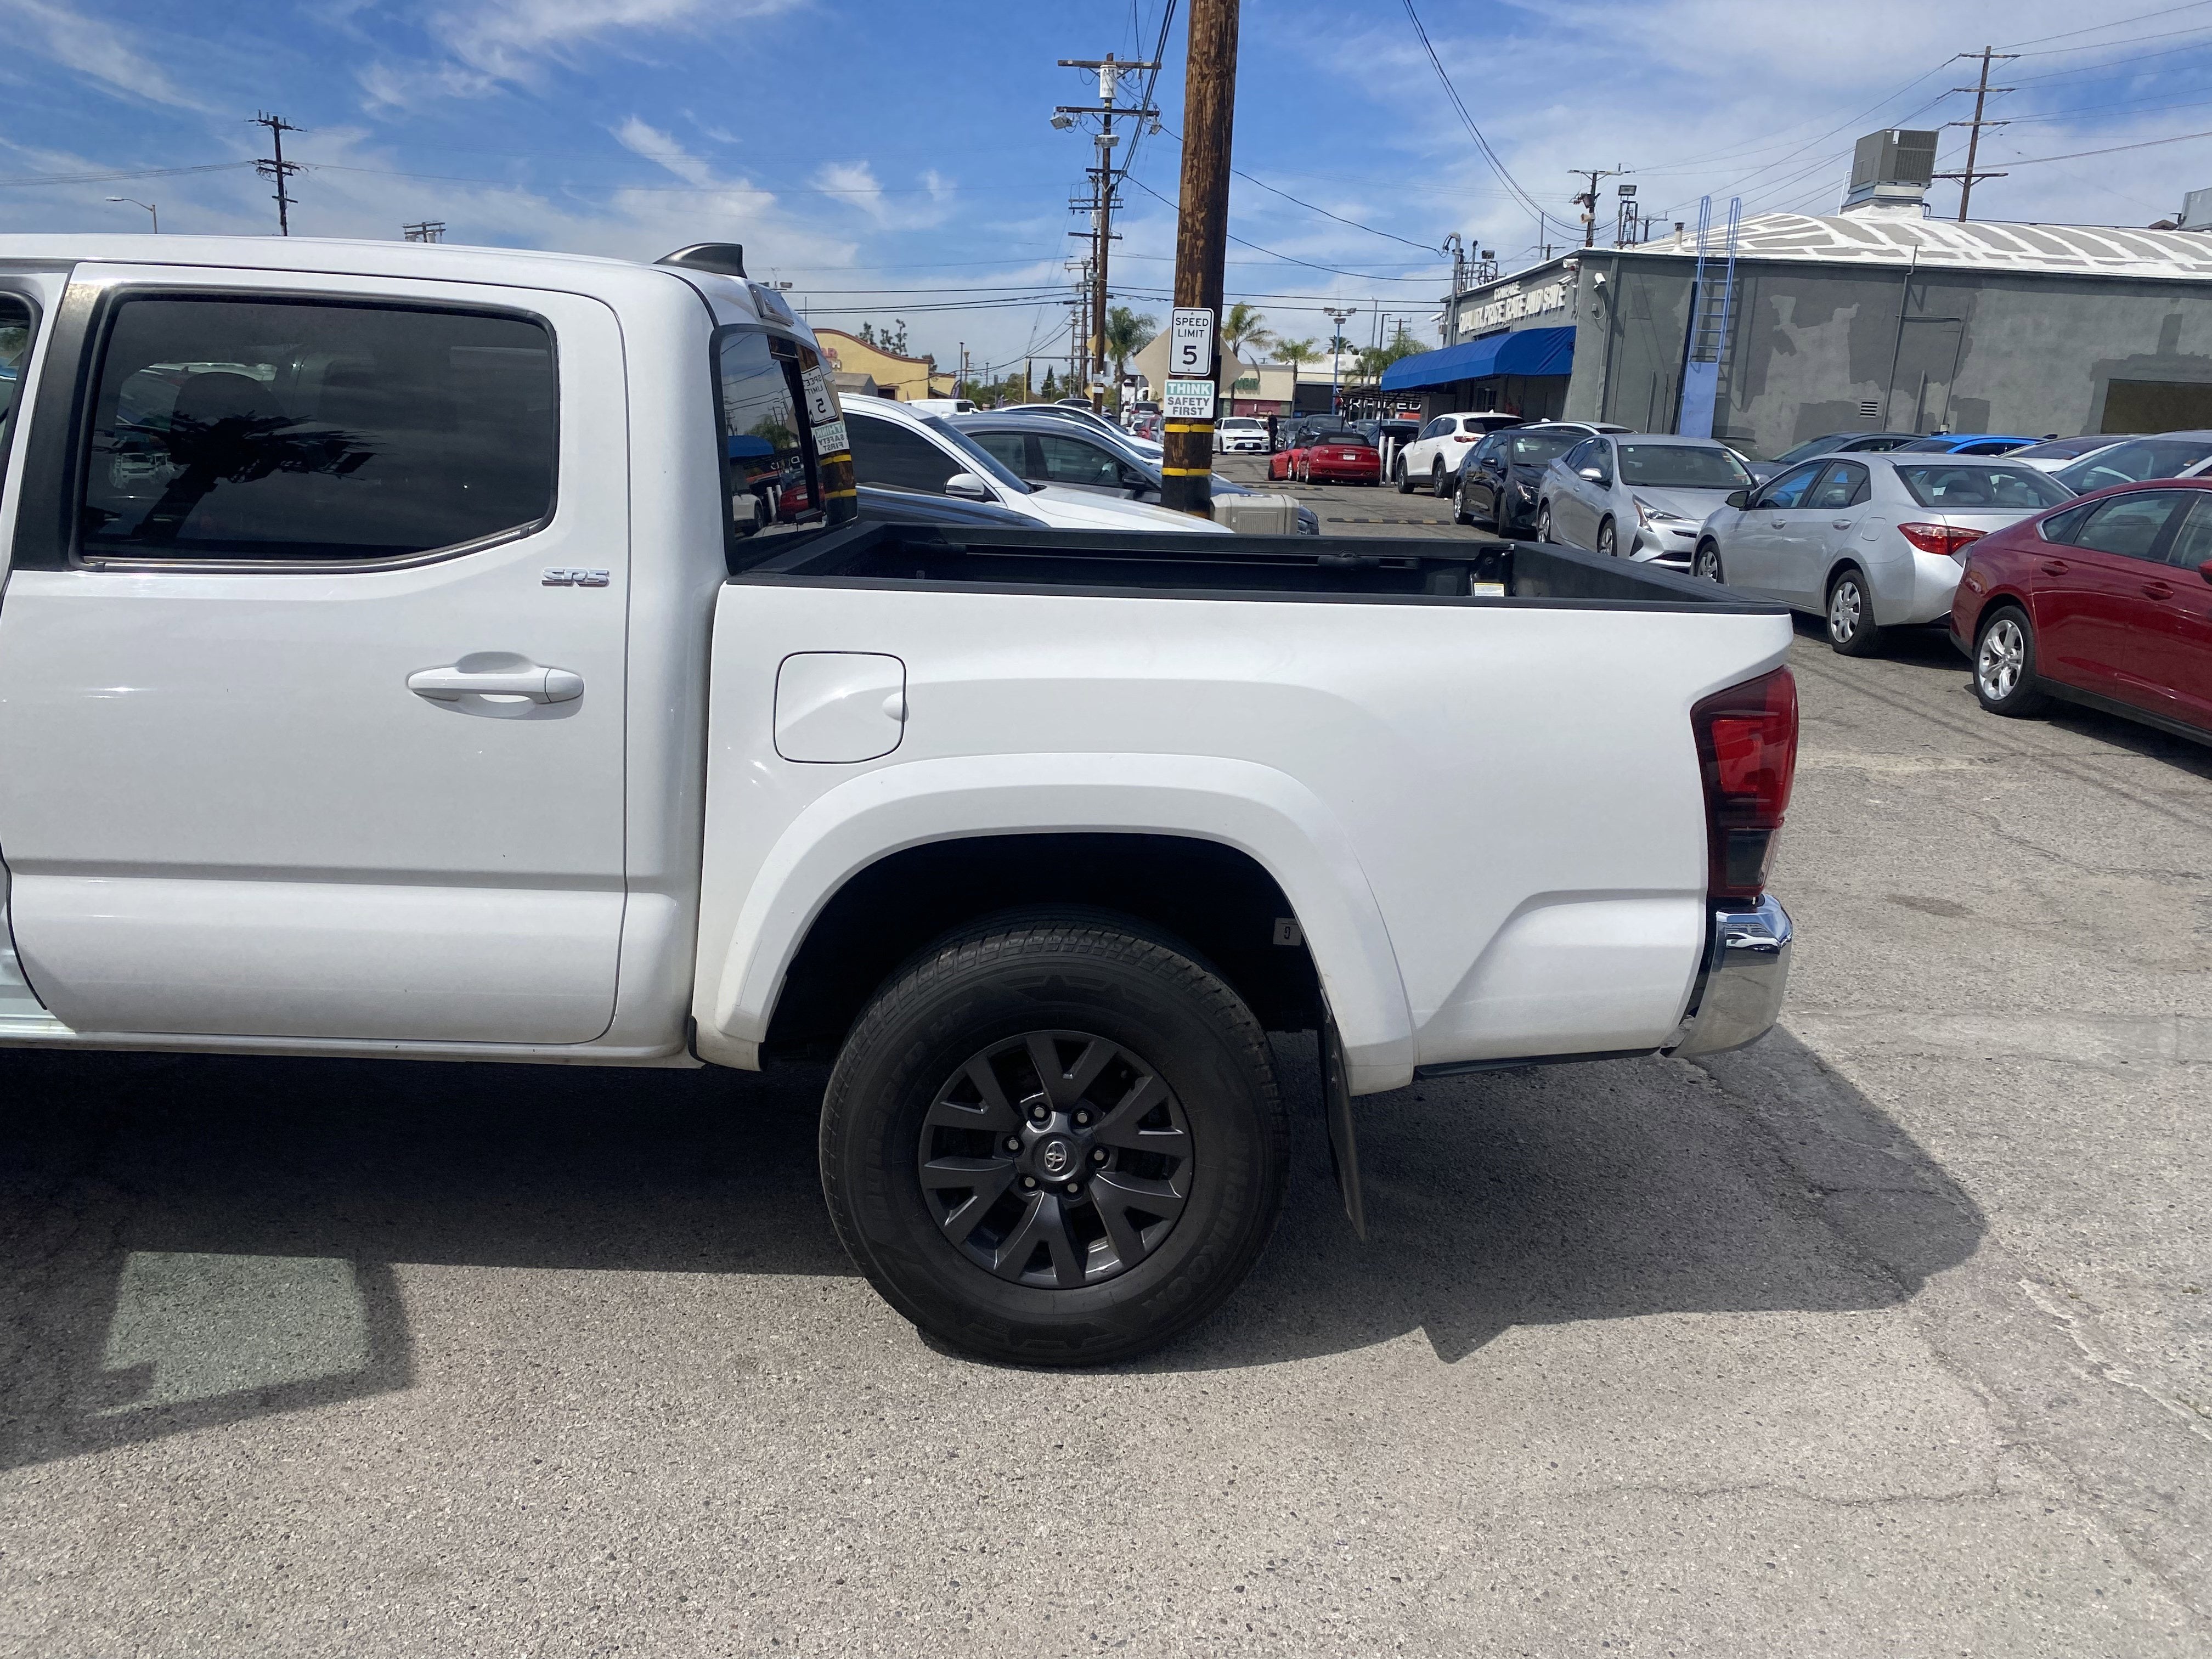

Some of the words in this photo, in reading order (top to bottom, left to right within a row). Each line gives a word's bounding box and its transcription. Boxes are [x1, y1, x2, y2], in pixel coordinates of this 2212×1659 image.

[1506, 294, 1526, 320] RATE
[1526, 289, 1544, 315] AND
[1543, 284, 1567, 311] SAVE
[1175, 317, 1209, 326] SPEED
[1178, 329, 1205, 338] LIMIT
[1182, 345, 1197, 365] 5
[1168, 383, 1211, 395] THINK
[1167, 397, 1210, 407] SAFETY
[1172, 407, 1204, 416] FIRST
[541, 568, 610, 587] SR5
